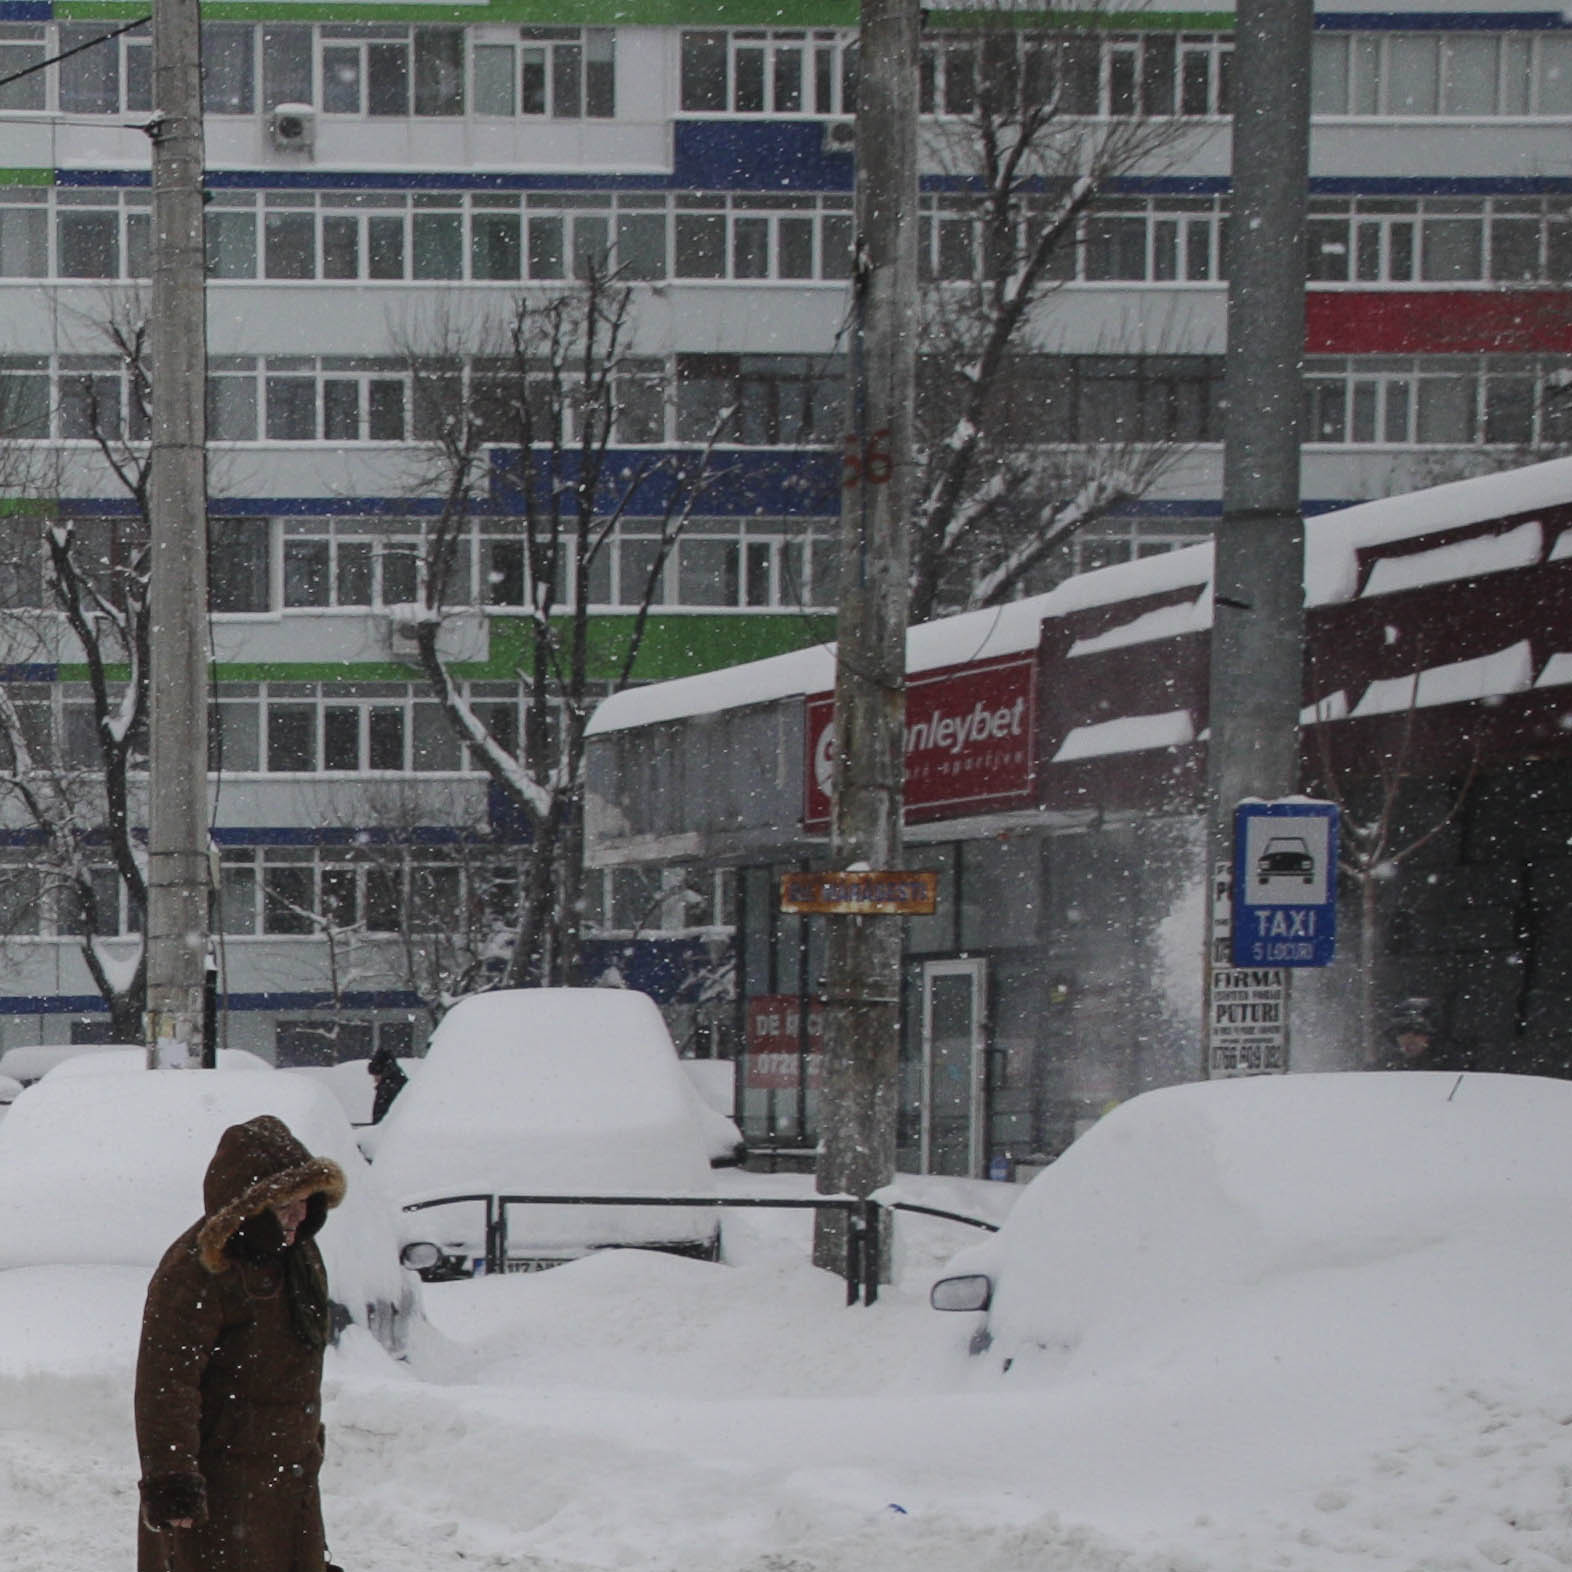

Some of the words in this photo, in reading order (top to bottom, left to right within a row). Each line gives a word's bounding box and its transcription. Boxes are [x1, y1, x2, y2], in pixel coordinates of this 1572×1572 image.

[903, 697, 1024, 754] nleybet
[1254, 909, 1316, 937] TAXI
[1252, 942, 1265, 960] 5
[1214, 971, 1282, 988] FIRMA
